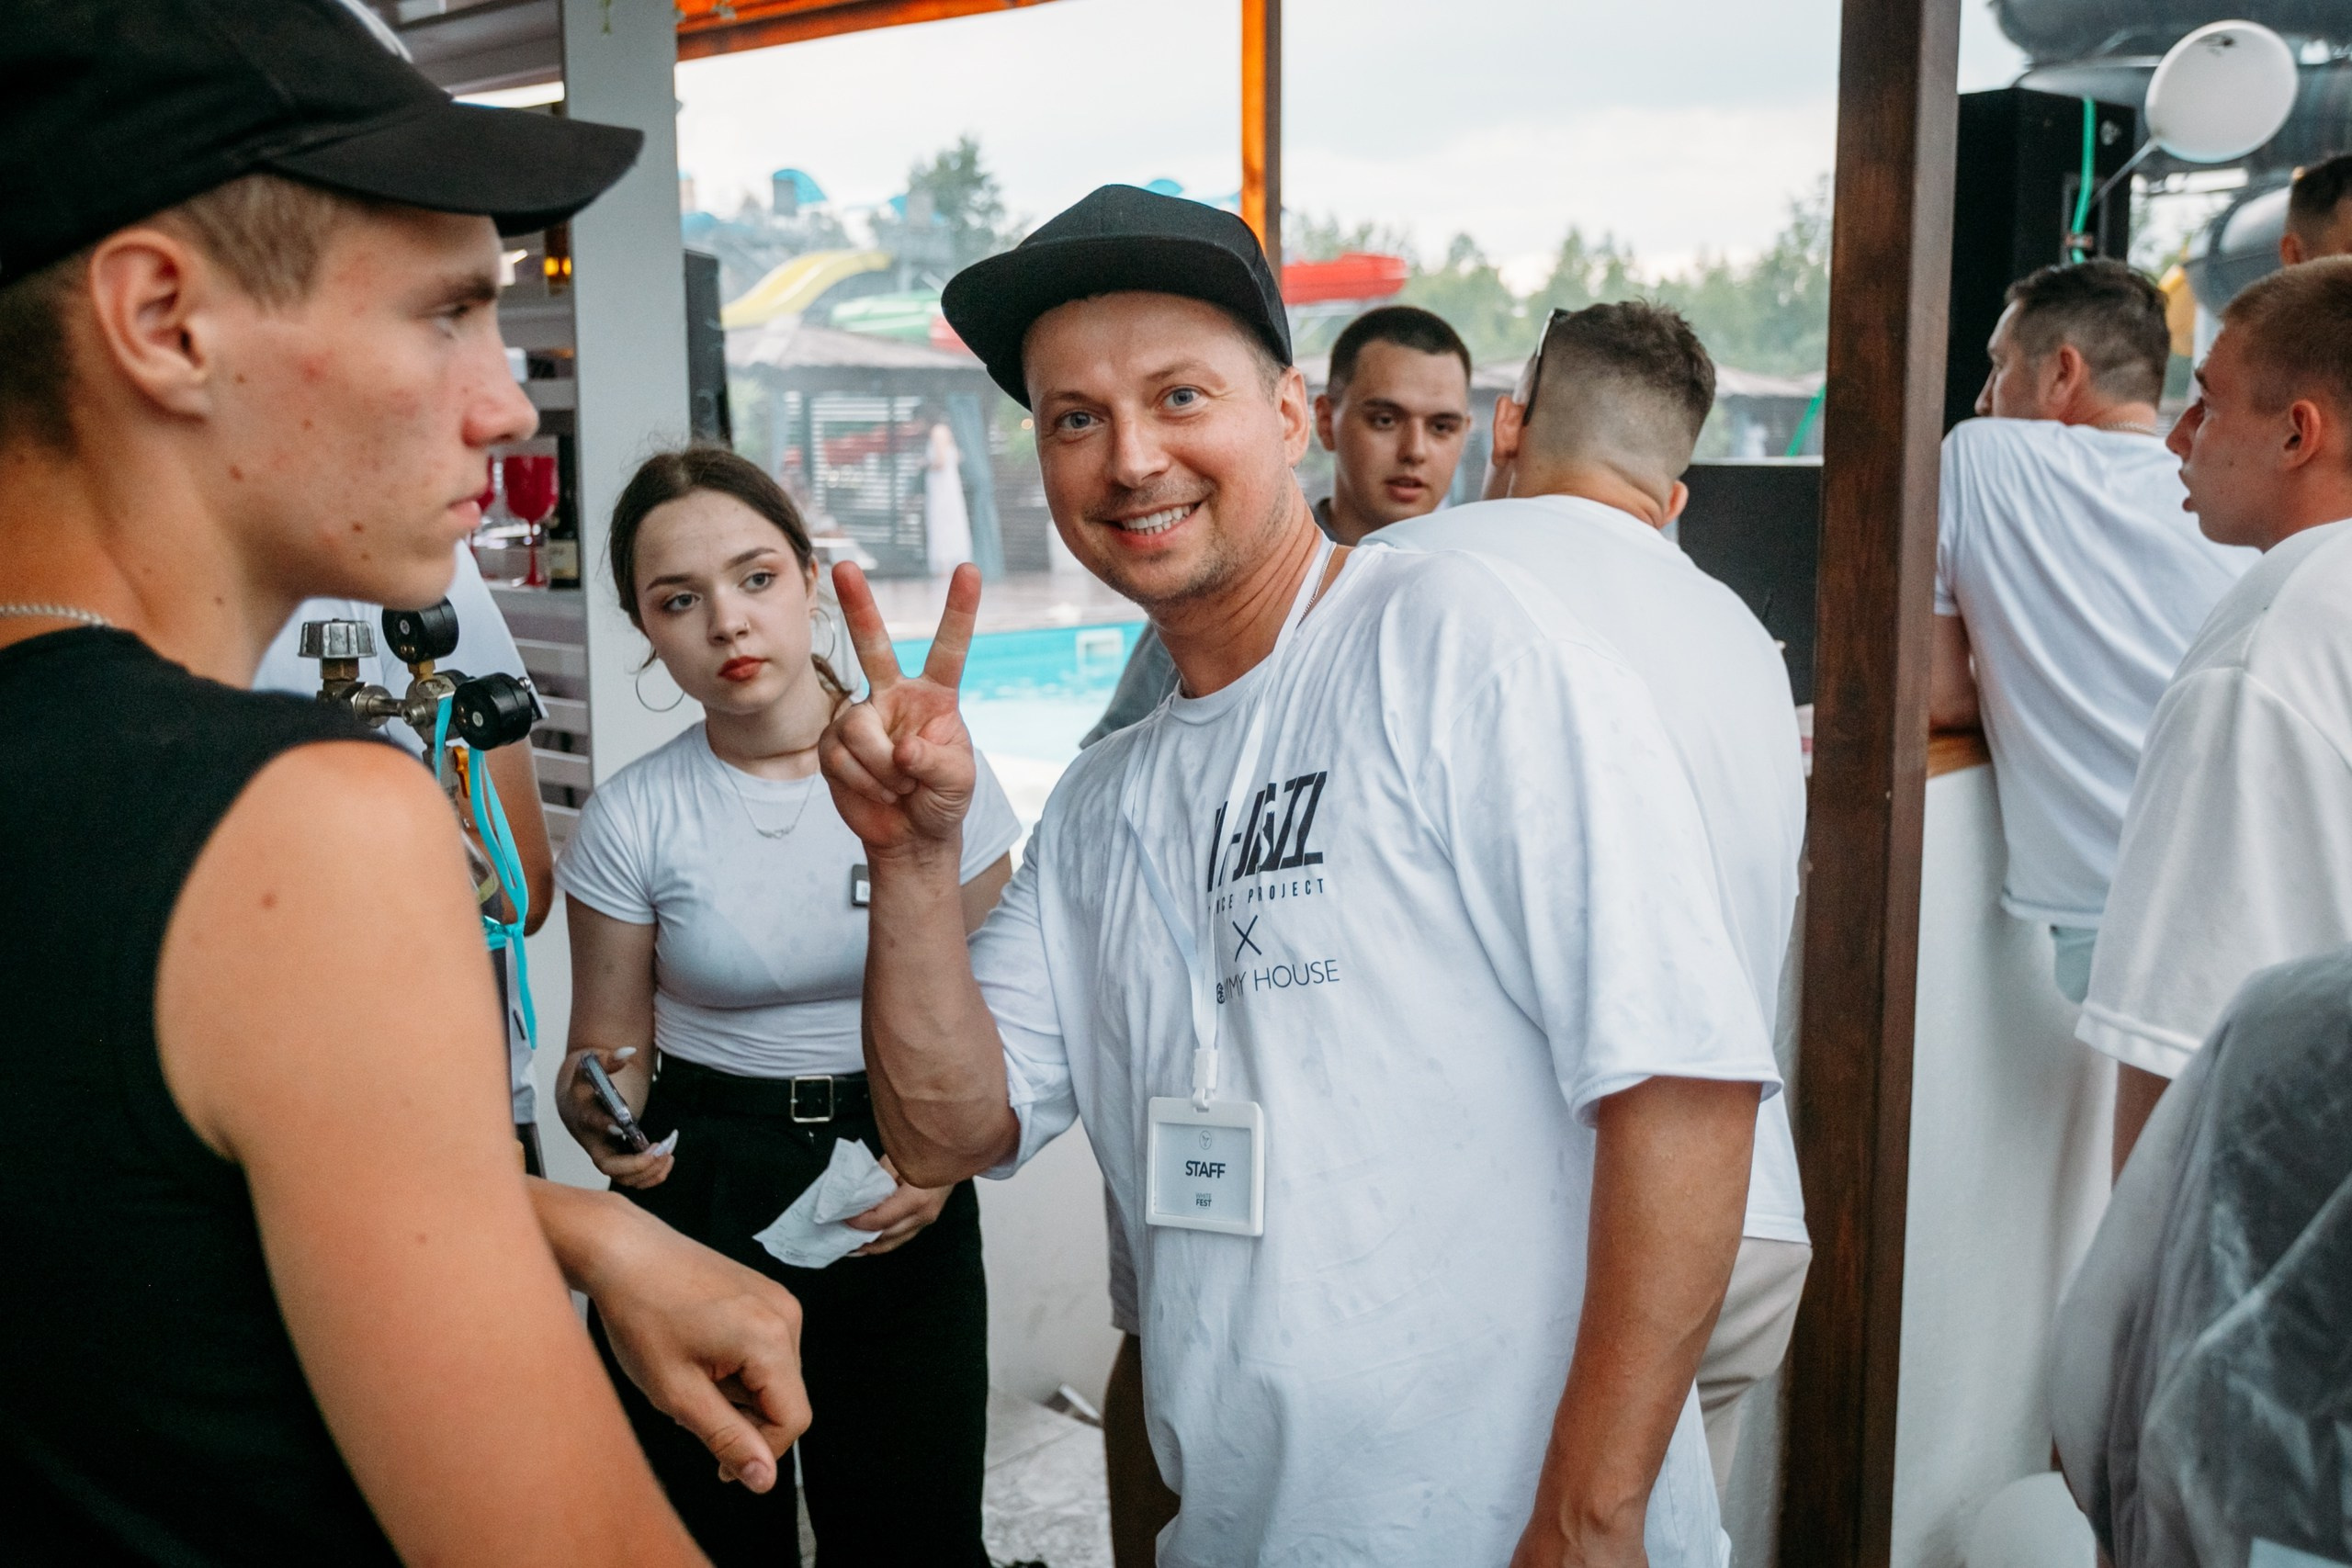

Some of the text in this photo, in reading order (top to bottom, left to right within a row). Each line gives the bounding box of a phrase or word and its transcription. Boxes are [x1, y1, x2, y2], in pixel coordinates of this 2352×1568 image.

[1248, 878, 1324, 903] PROJECT
[1254, 960, 1340, 991] HOUSE
[1185, 1160, 1226, 1179] STAFF
[1195, 1198, 1212, 1207] FEST
